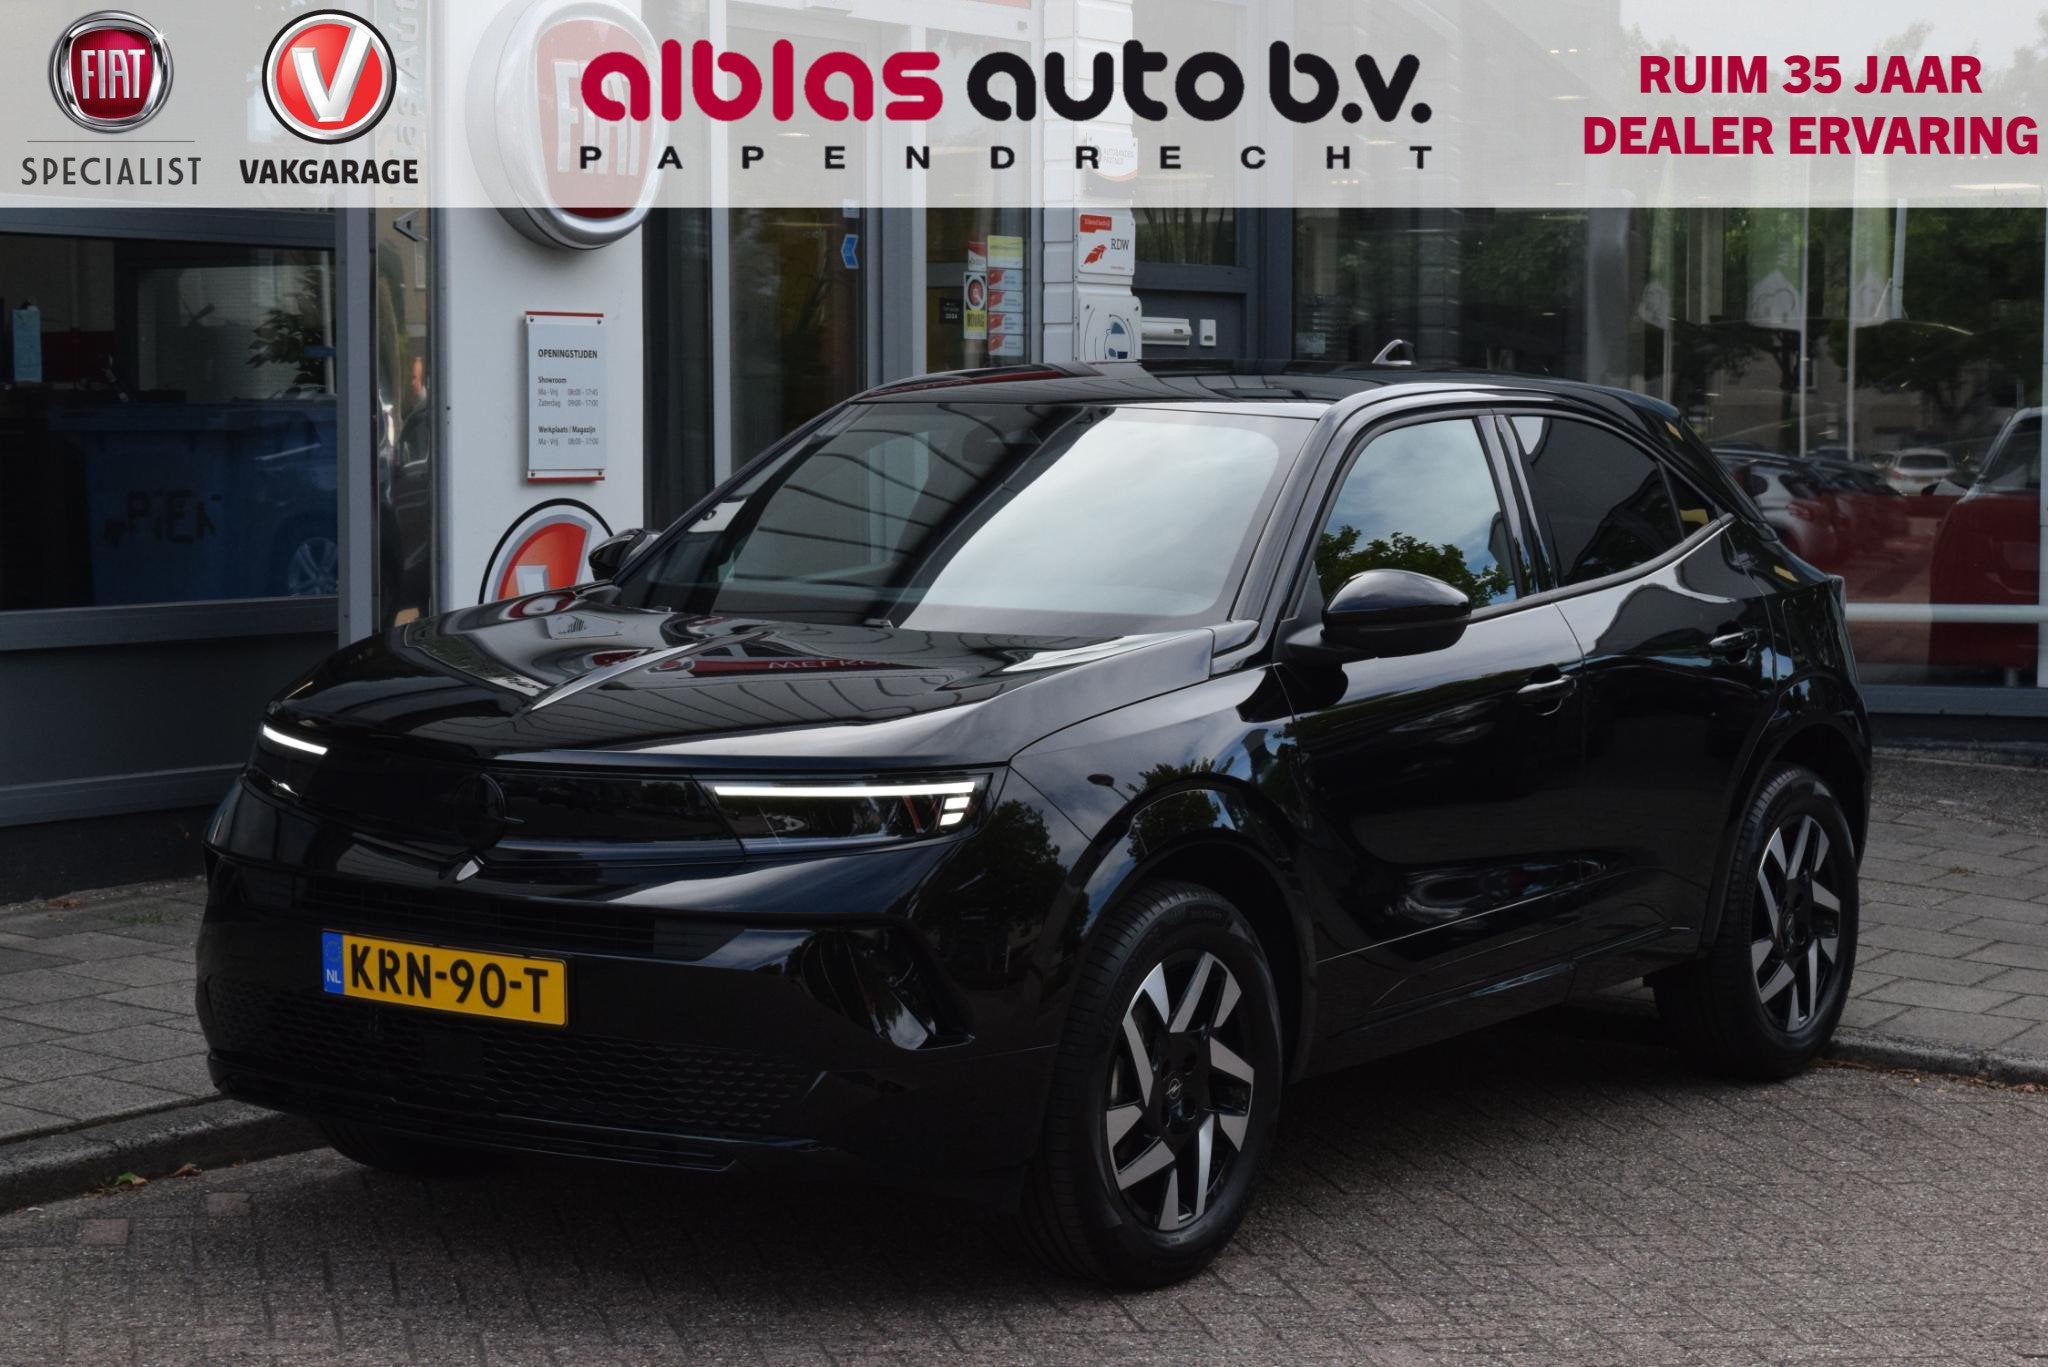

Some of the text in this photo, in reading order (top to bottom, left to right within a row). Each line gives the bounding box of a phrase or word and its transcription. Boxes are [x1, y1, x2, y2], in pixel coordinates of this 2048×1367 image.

[1110, 238, 1130, 251] RDW
[538, 348, 598, 359] OPENINGSTIJDEN
[538, 376, 567, 384] Showroom
[538, 426, 568, 435] Werkplaats
[326, 970, 342, 984] NL
[350, 943, 549, 1014] KRN-90-T
